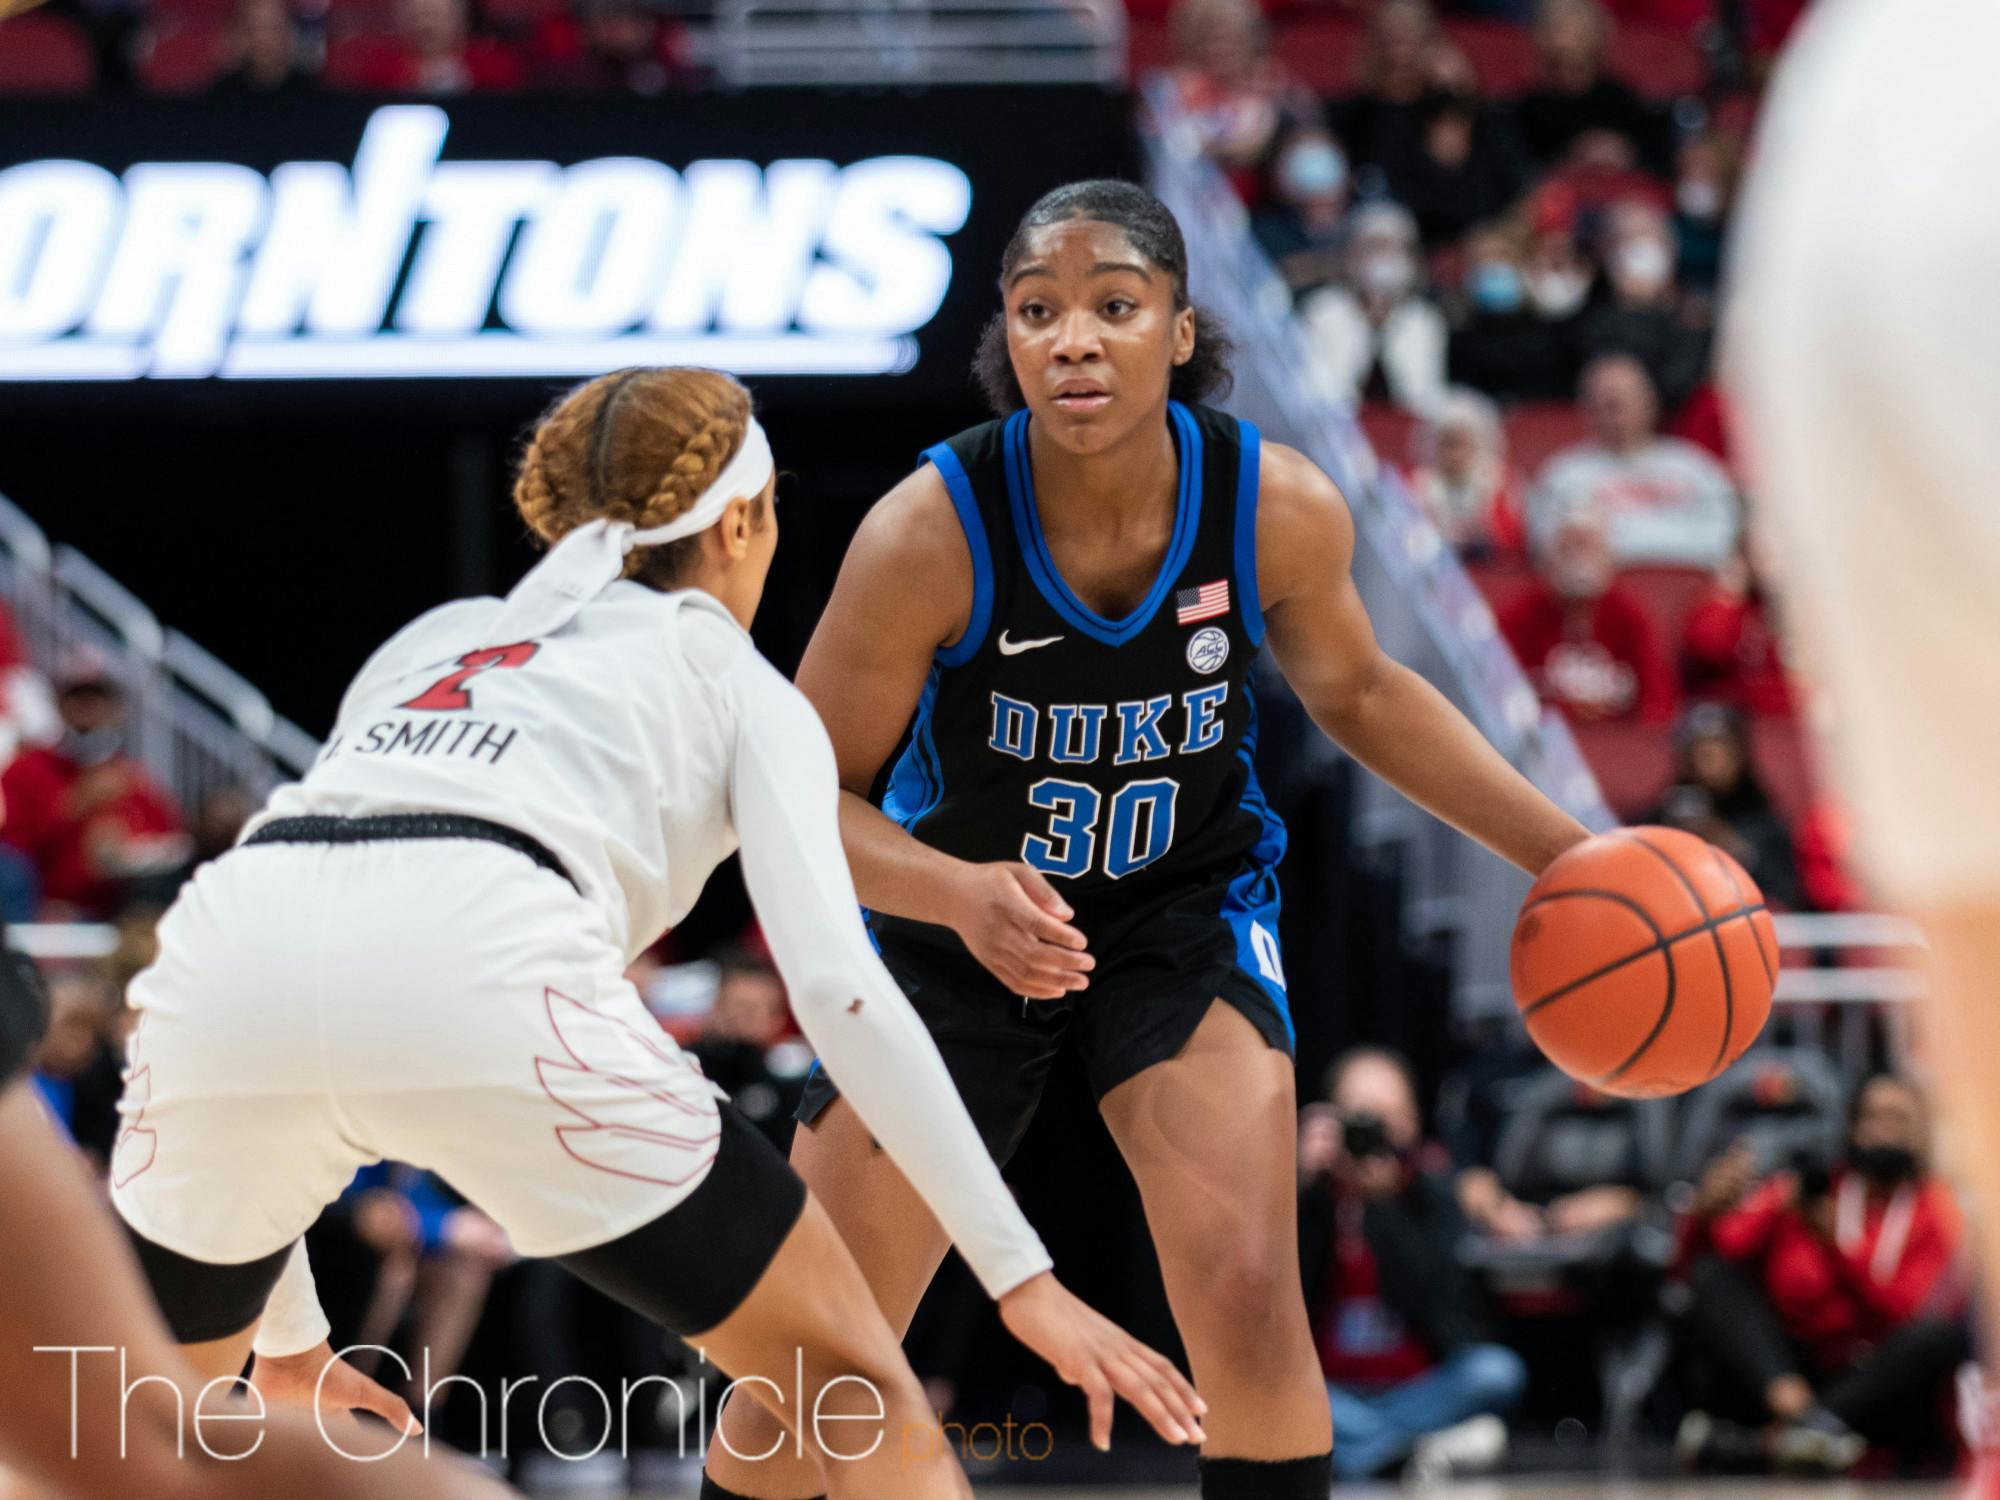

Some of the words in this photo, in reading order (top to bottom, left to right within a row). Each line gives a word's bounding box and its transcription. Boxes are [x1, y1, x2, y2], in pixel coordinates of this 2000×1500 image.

[394, 640, 542, 711] 2
[355, 719, 518, 765] SMITH
[988, 681, 1229, 766] DUKE
[1020, 777, 1180, 880] 30
